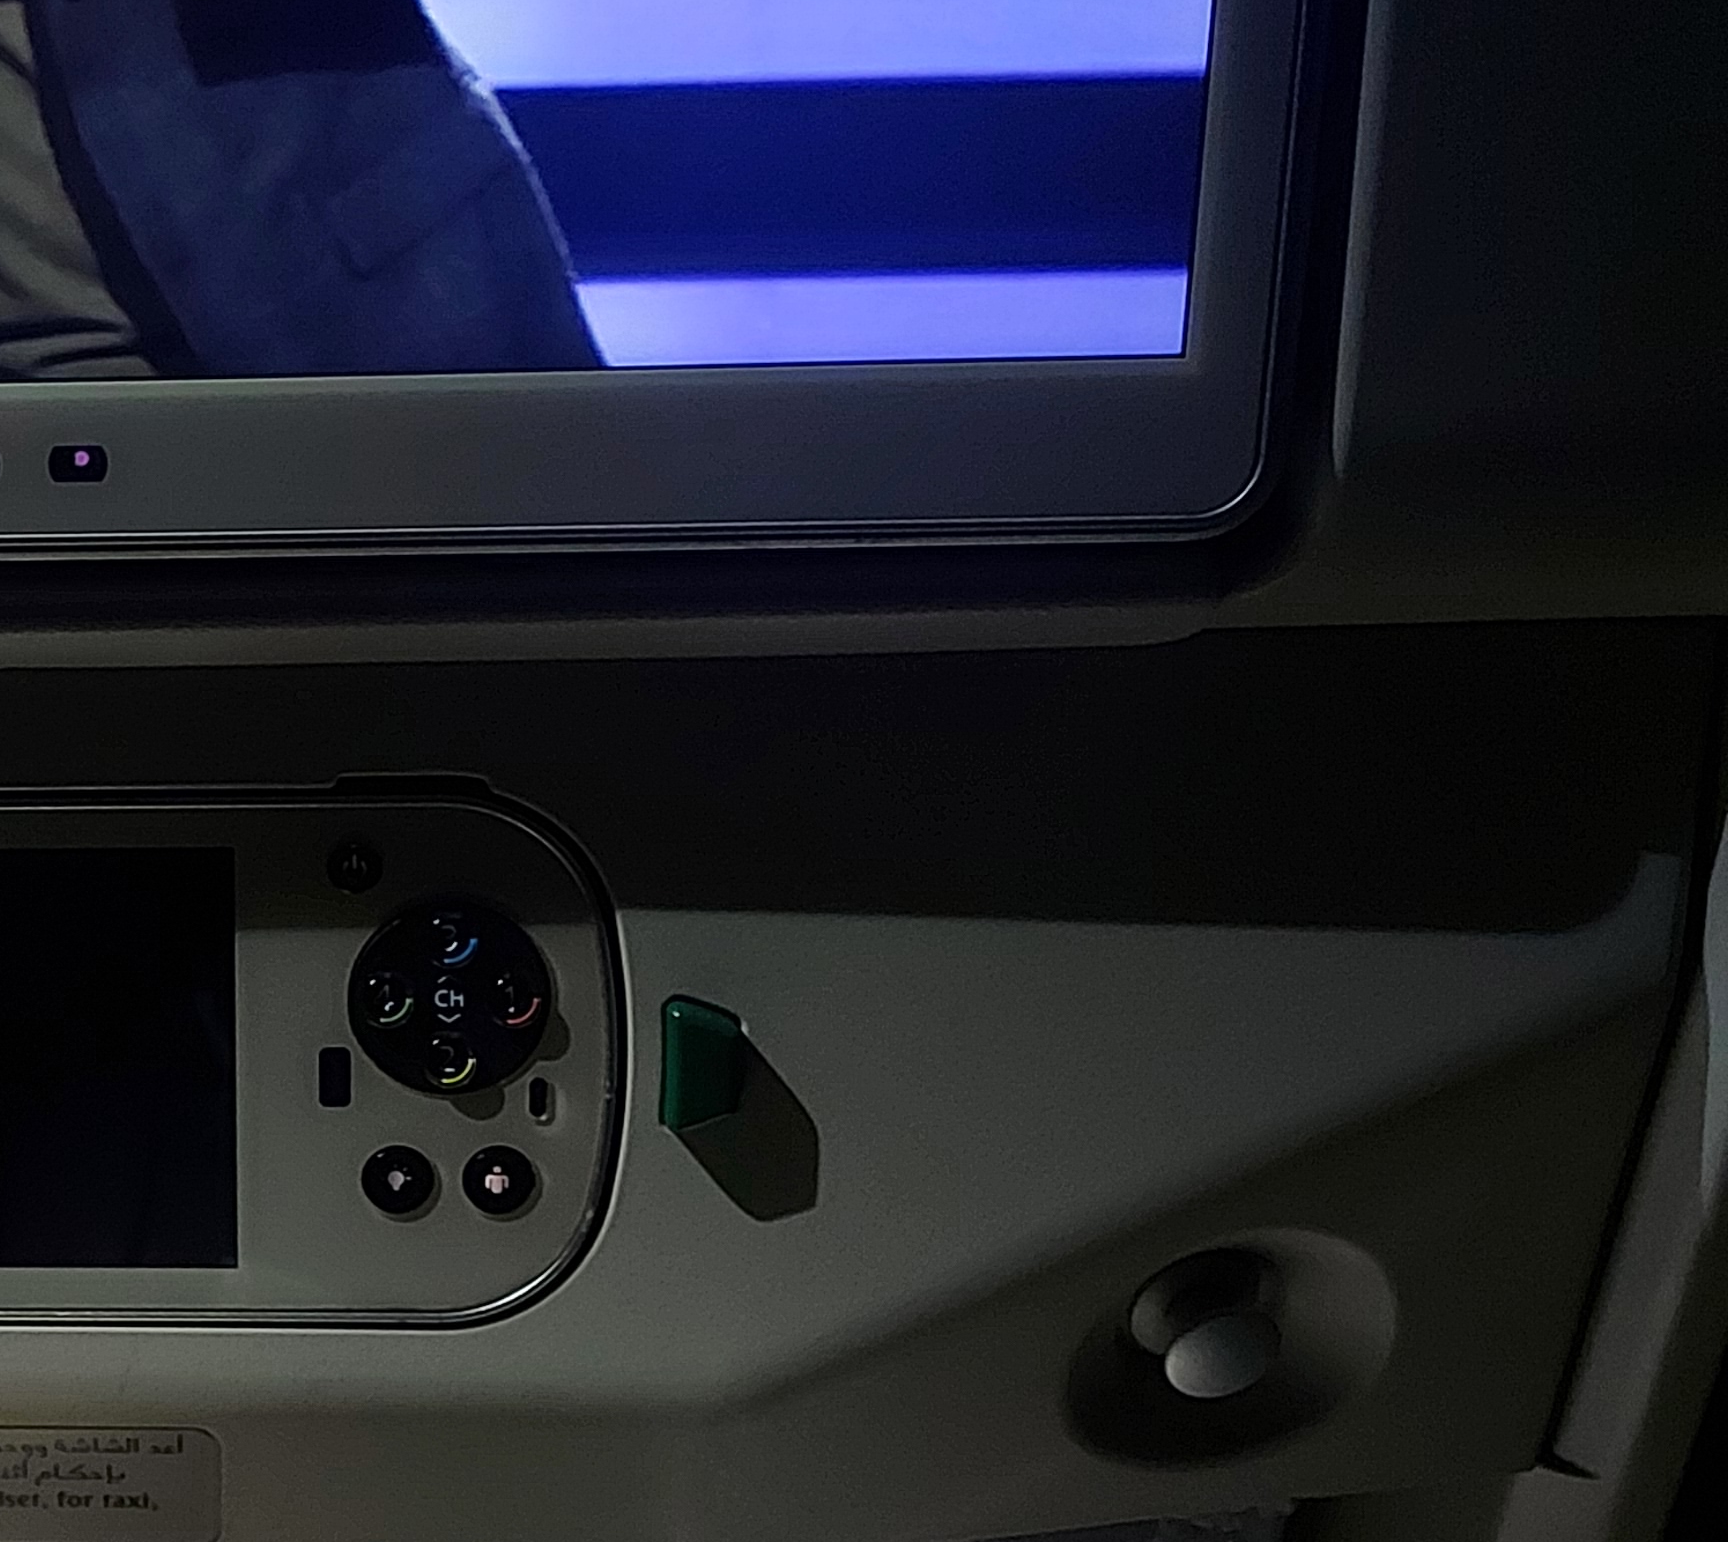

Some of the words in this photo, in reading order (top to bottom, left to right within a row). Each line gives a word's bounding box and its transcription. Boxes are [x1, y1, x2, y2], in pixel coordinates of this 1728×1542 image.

[433, 988, 466, 1009] CH
[53, 1436, 140, 1454] الشاشة
[57, 1490, 94, 1509] for
[102, 1490, 160, 1512] taxi,
